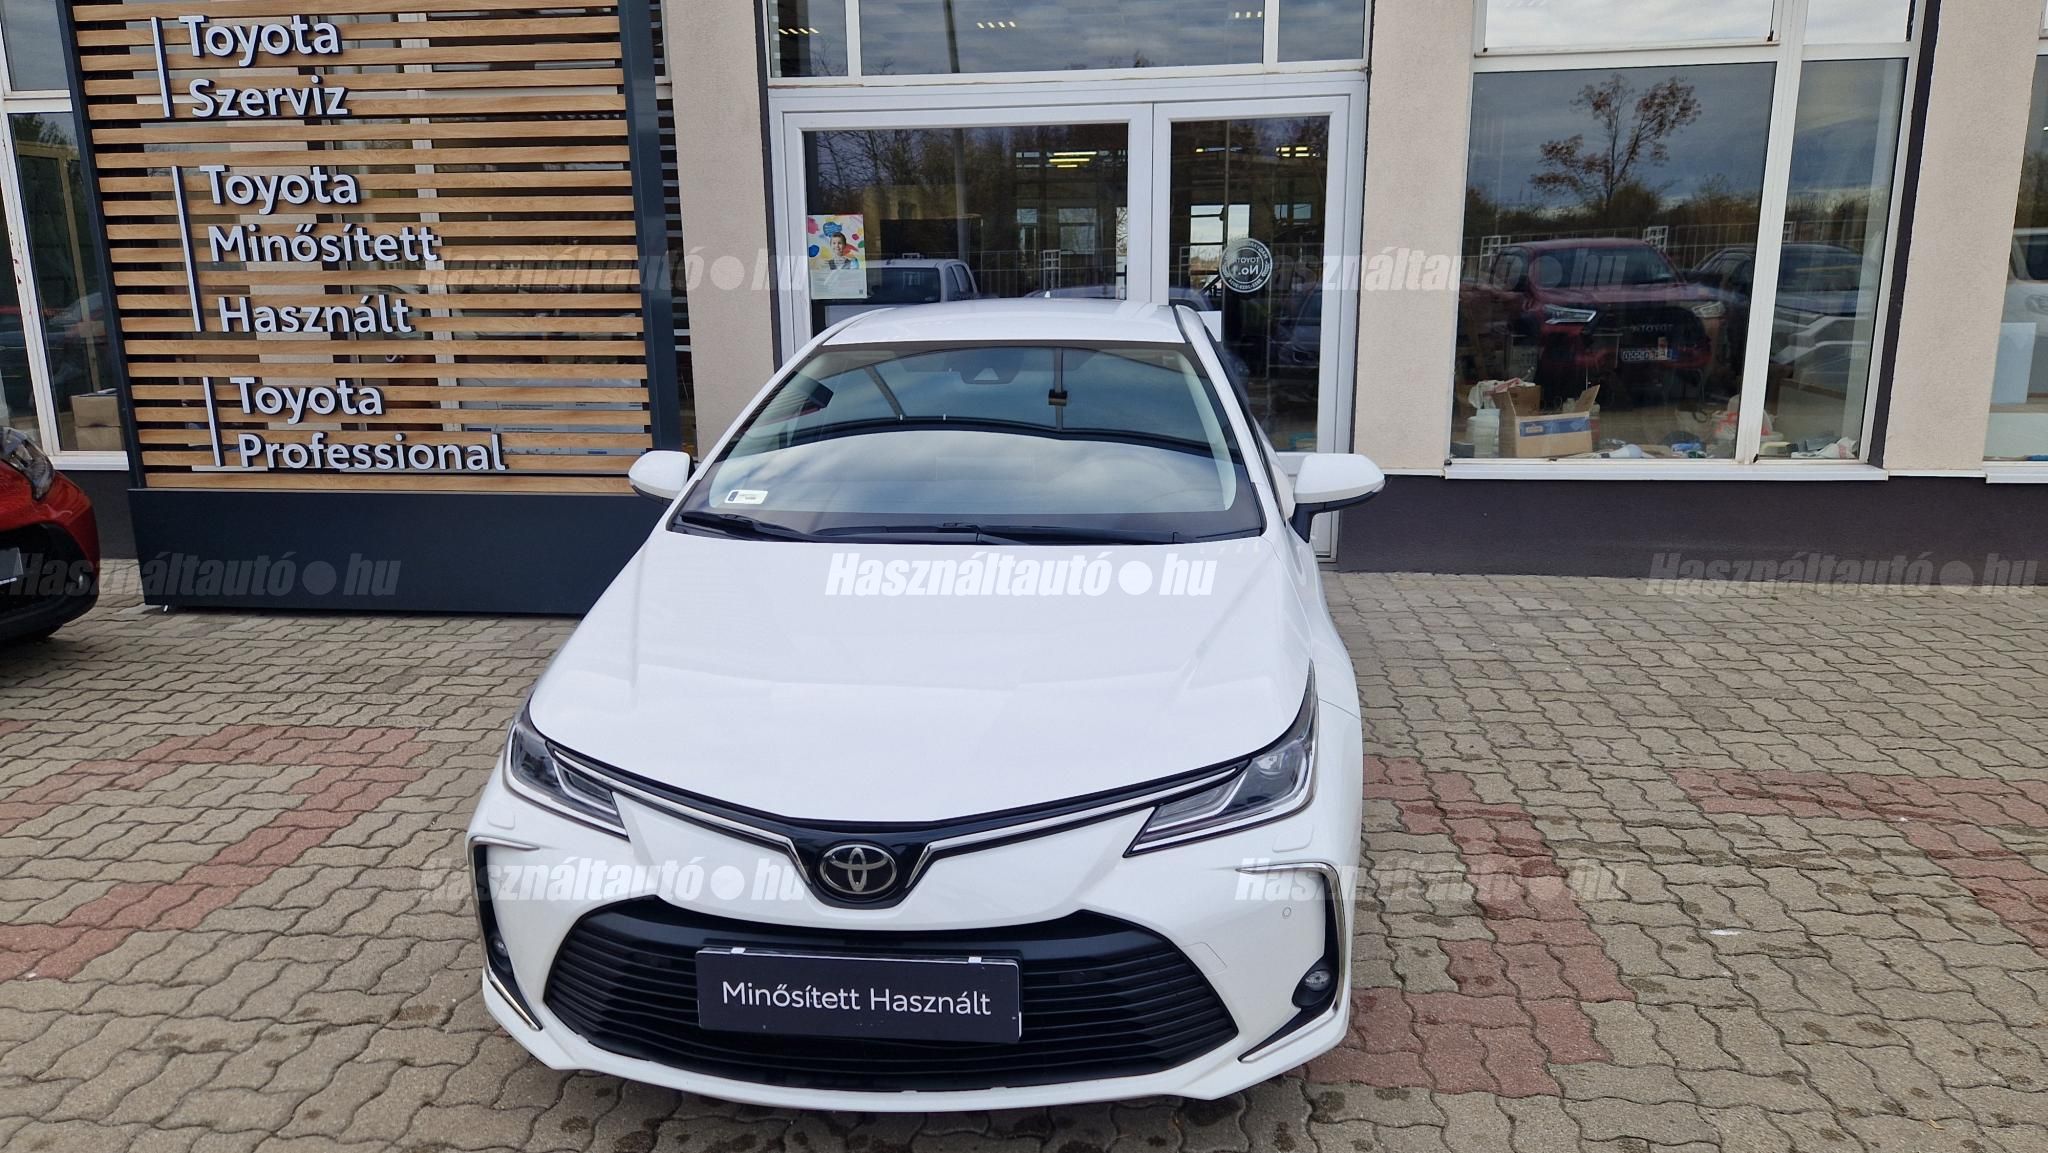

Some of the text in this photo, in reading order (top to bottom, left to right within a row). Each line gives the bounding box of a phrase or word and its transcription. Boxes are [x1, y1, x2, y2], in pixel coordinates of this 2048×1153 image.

[178, 15, 341, 68] Toyota
[188, 74, 350, 118] Szerviz
[199, 165, 359, 215] Toyota
[207, 223, 439, 263] Minősített
[218, 294, 413, 333] Használt
[229, 376, 385, 425] Toyota
[237, 432, 508, 471] Professional
[722, 980, 992, 1016] Minősített Használt
